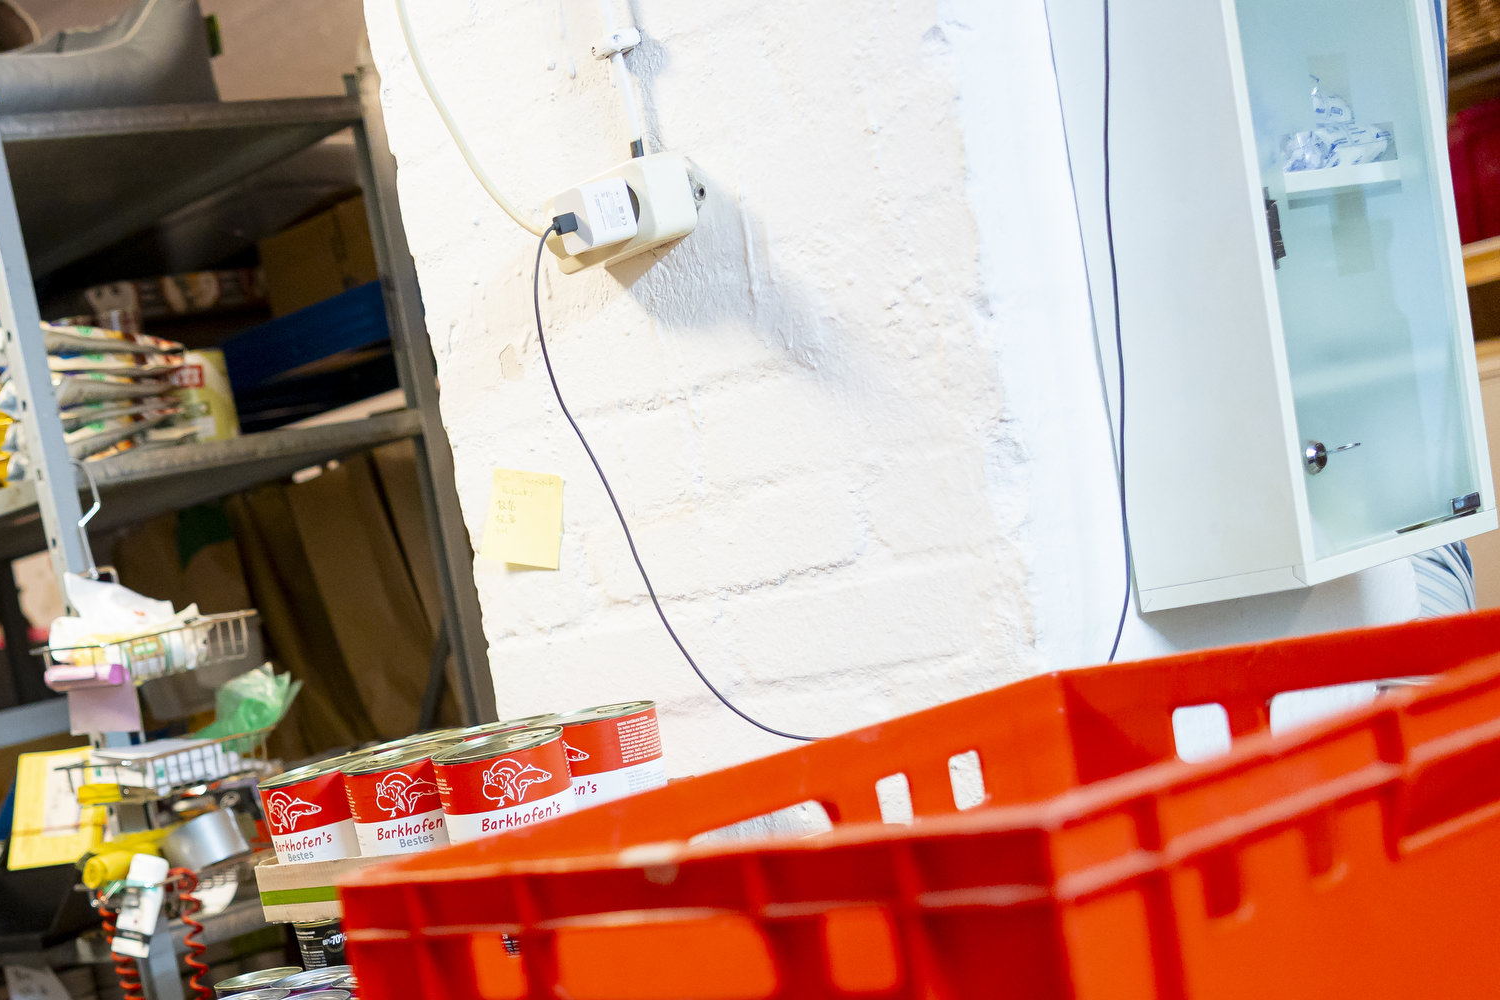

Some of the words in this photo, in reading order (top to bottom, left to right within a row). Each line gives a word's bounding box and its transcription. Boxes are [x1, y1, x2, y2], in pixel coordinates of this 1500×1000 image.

[480, 801, 561, 832] Barkhofen's
[377, 817, 443, 841] Barkhofen
[399, 833, 435, 848] Bestes
[287, 851, 314, 862] Bestes
